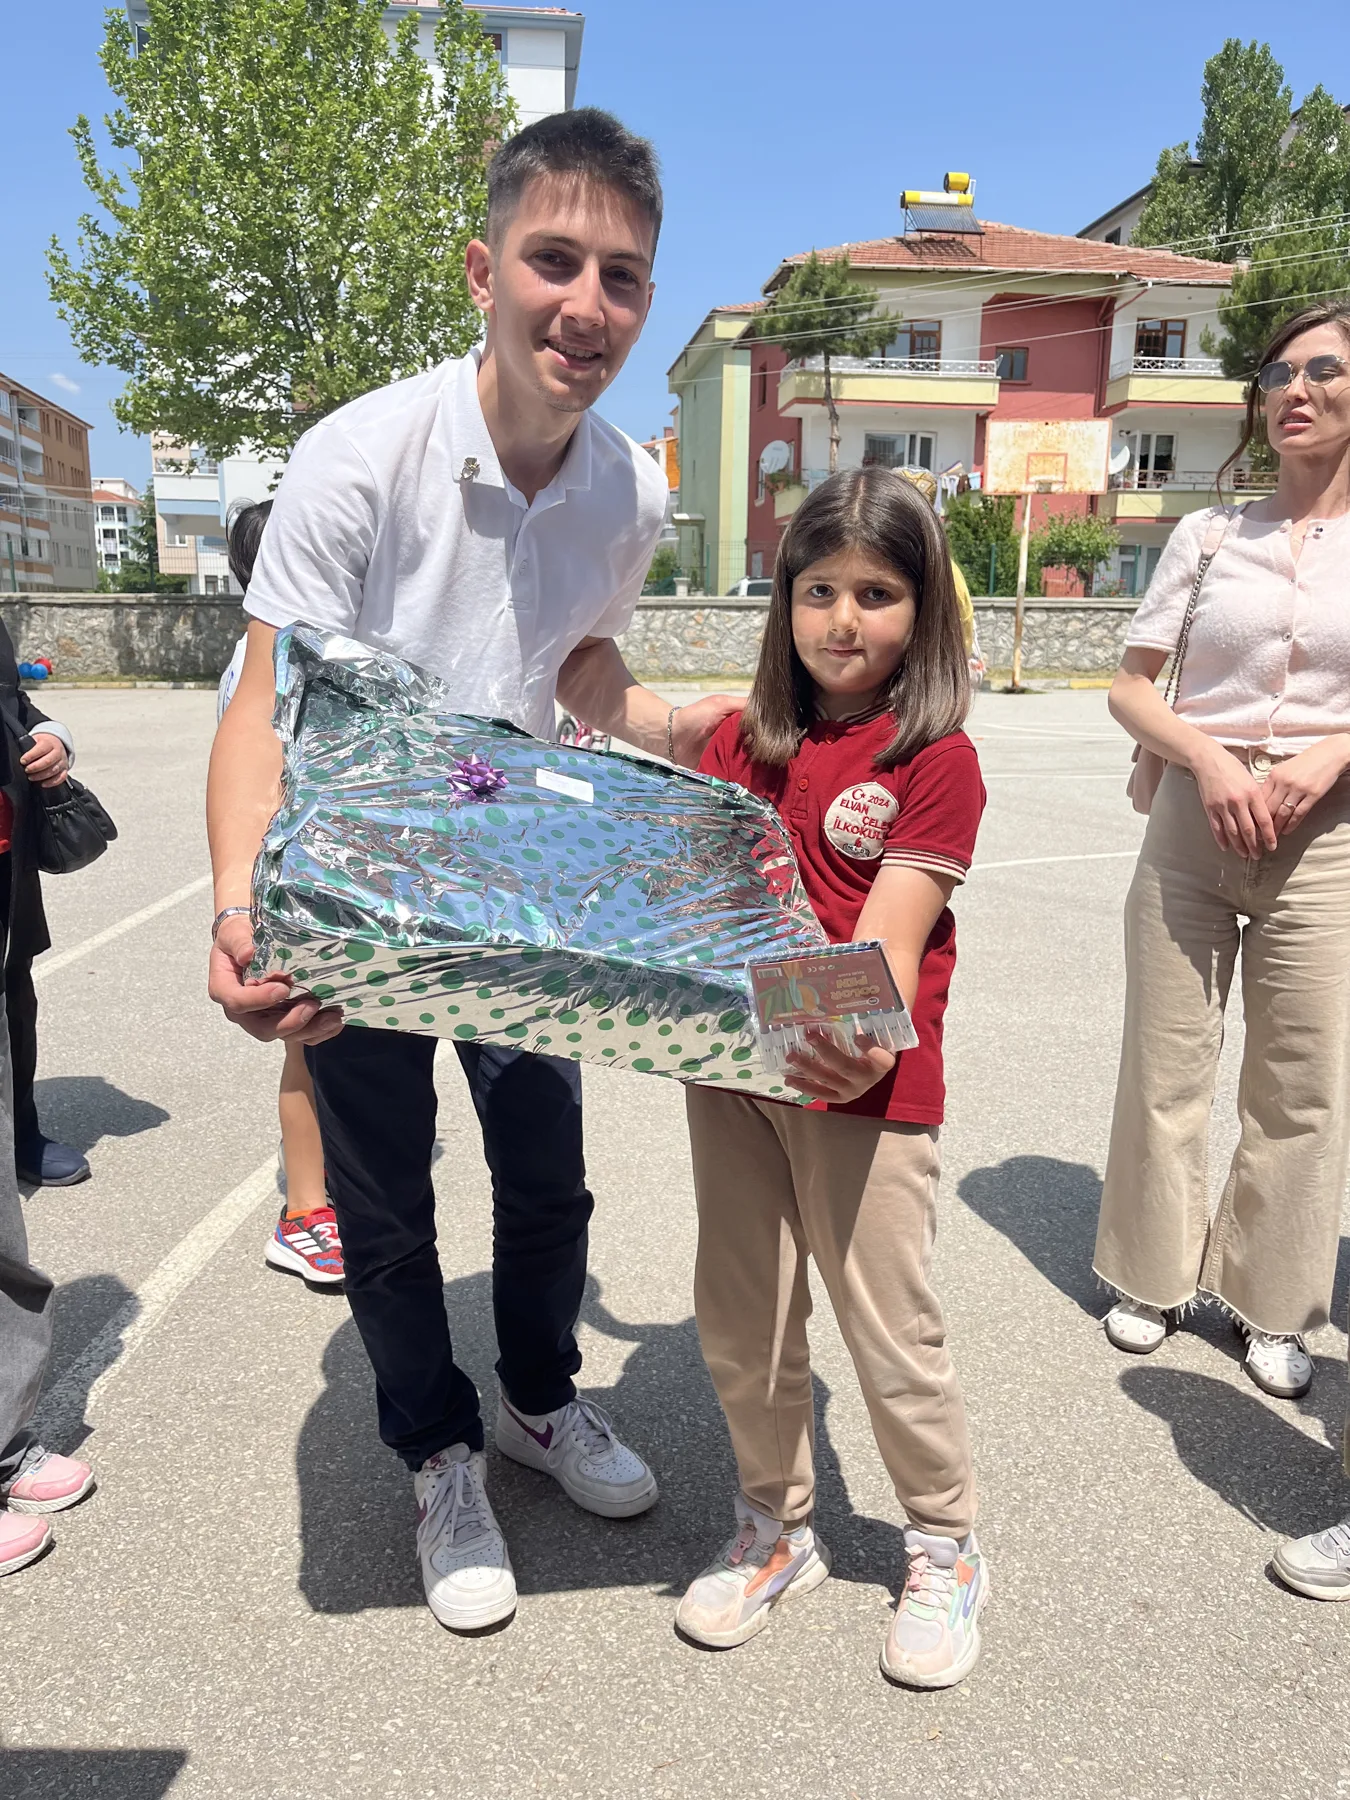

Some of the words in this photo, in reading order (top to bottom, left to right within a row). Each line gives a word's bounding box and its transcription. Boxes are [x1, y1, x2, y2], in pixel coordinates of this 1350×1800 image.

[840, 799, 870, 815] ELVAN
[868, 796, 890, 808] 2024
[862, 816, 888, 830] ÇELE
[836, 976, 868, 989] PEN
[831, 986, 881, 1001] COLOR
